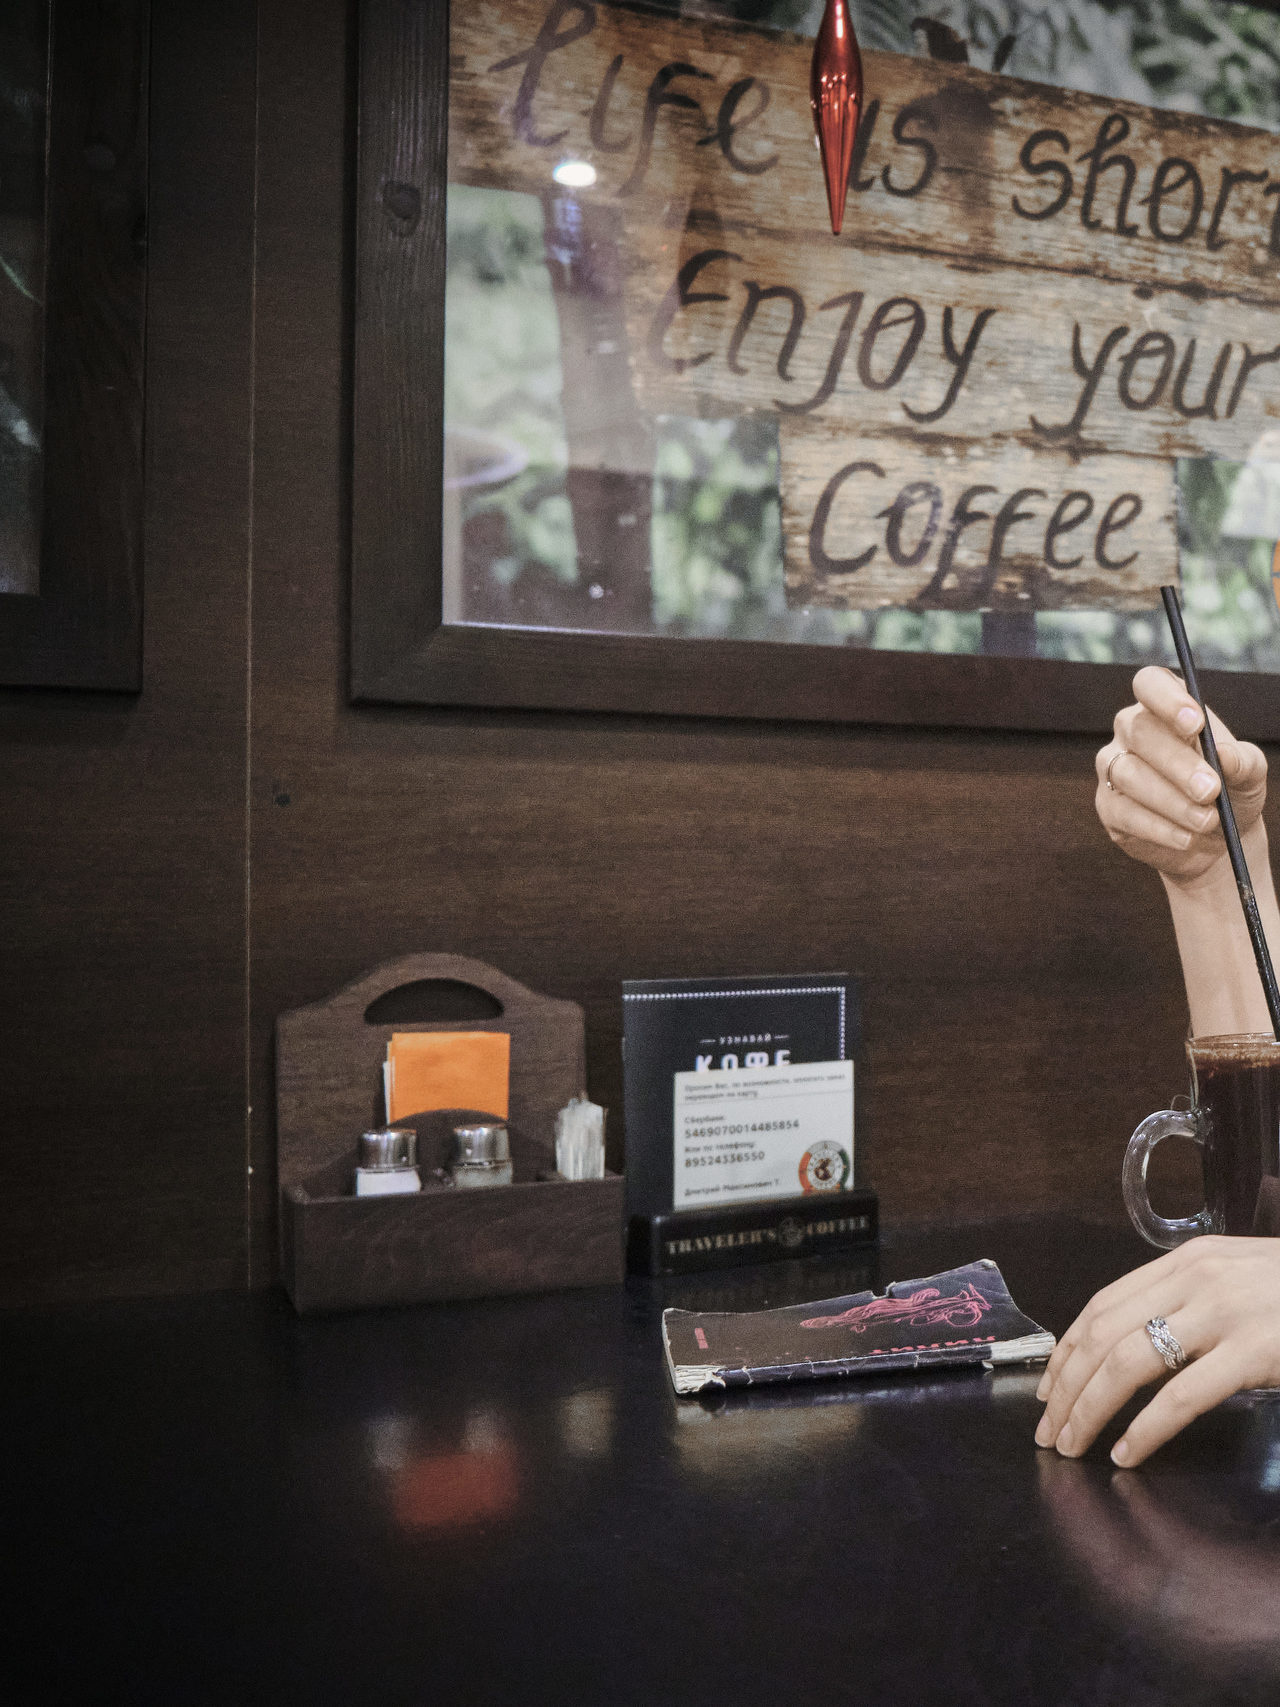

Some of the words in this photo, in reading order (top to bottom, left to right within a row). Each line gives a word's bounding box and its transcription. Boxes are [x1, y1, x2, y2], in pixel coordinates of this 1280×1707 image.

[488, 1, 778, 197] Life
[847, 100, 938, 198] is
[646, 248, 1002, 423] Enjoy
[809, 461, 1143, 600] Coffee
[720, 1032, 772, 1045] УЗНАВАЙ
